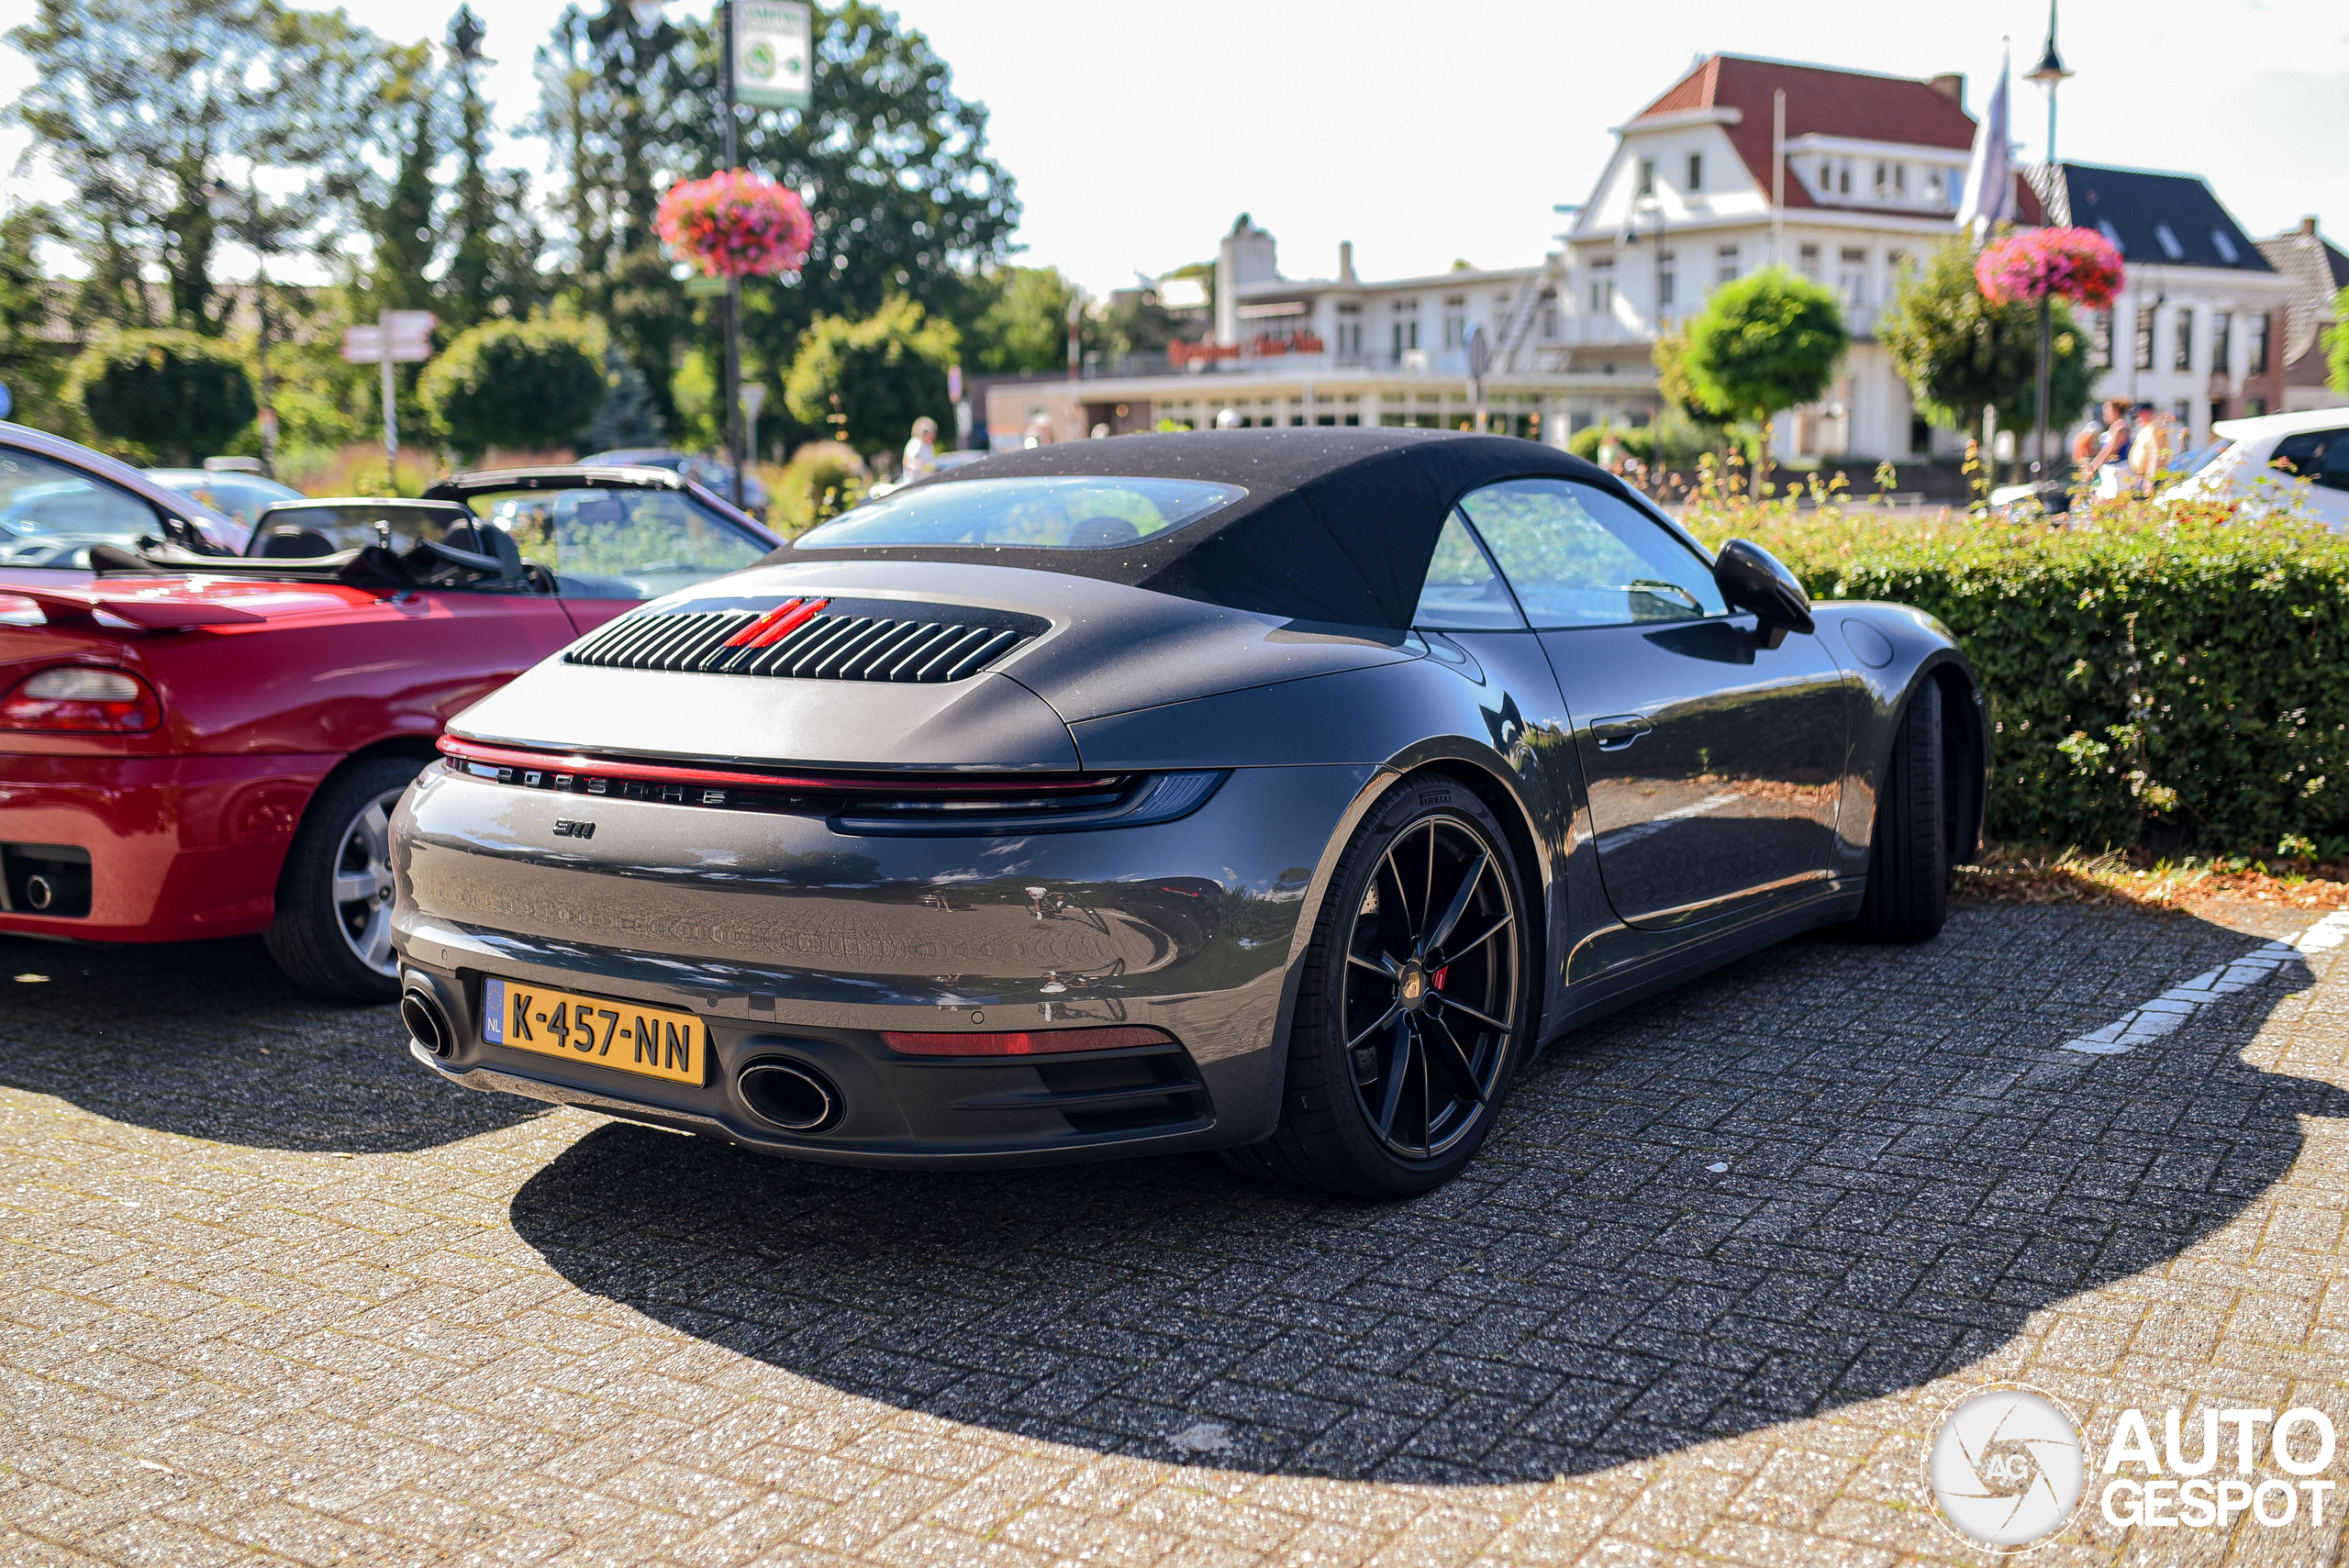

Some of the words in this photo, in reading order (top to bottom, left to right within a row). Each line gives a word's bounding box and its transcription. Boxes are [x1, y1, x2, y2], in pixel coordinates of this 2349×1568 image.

[496, 767, 728, 805] PORSCHE
[1419, 790, 1452, 806] PIRELLI
[552, 817, 596, 840] 911
[487, 1017, 501, 1033] NL
[512, 993, 690, 1073] K-457-NN
